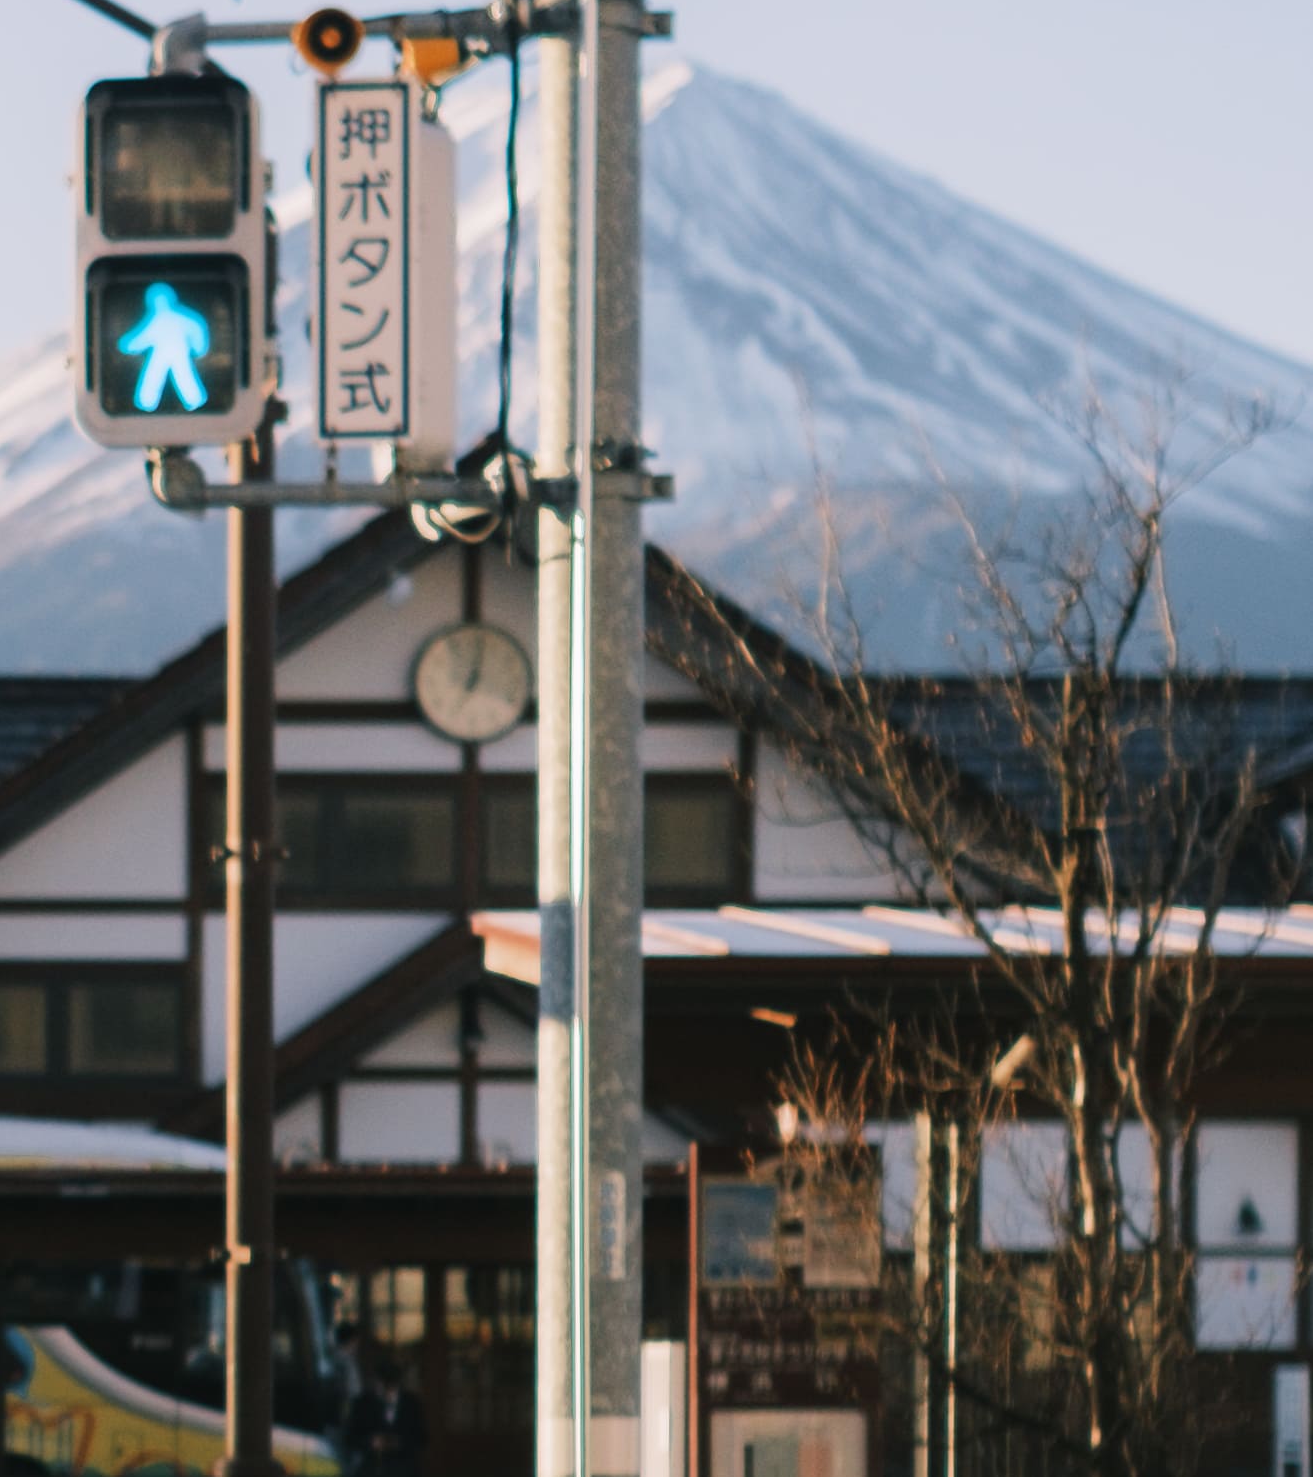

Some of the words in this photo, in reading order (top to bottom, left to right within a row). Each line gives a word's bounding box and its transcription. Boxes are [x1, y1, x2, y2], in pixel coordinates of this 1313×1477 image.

[337, 106, 392, 417] 押ボタン式
